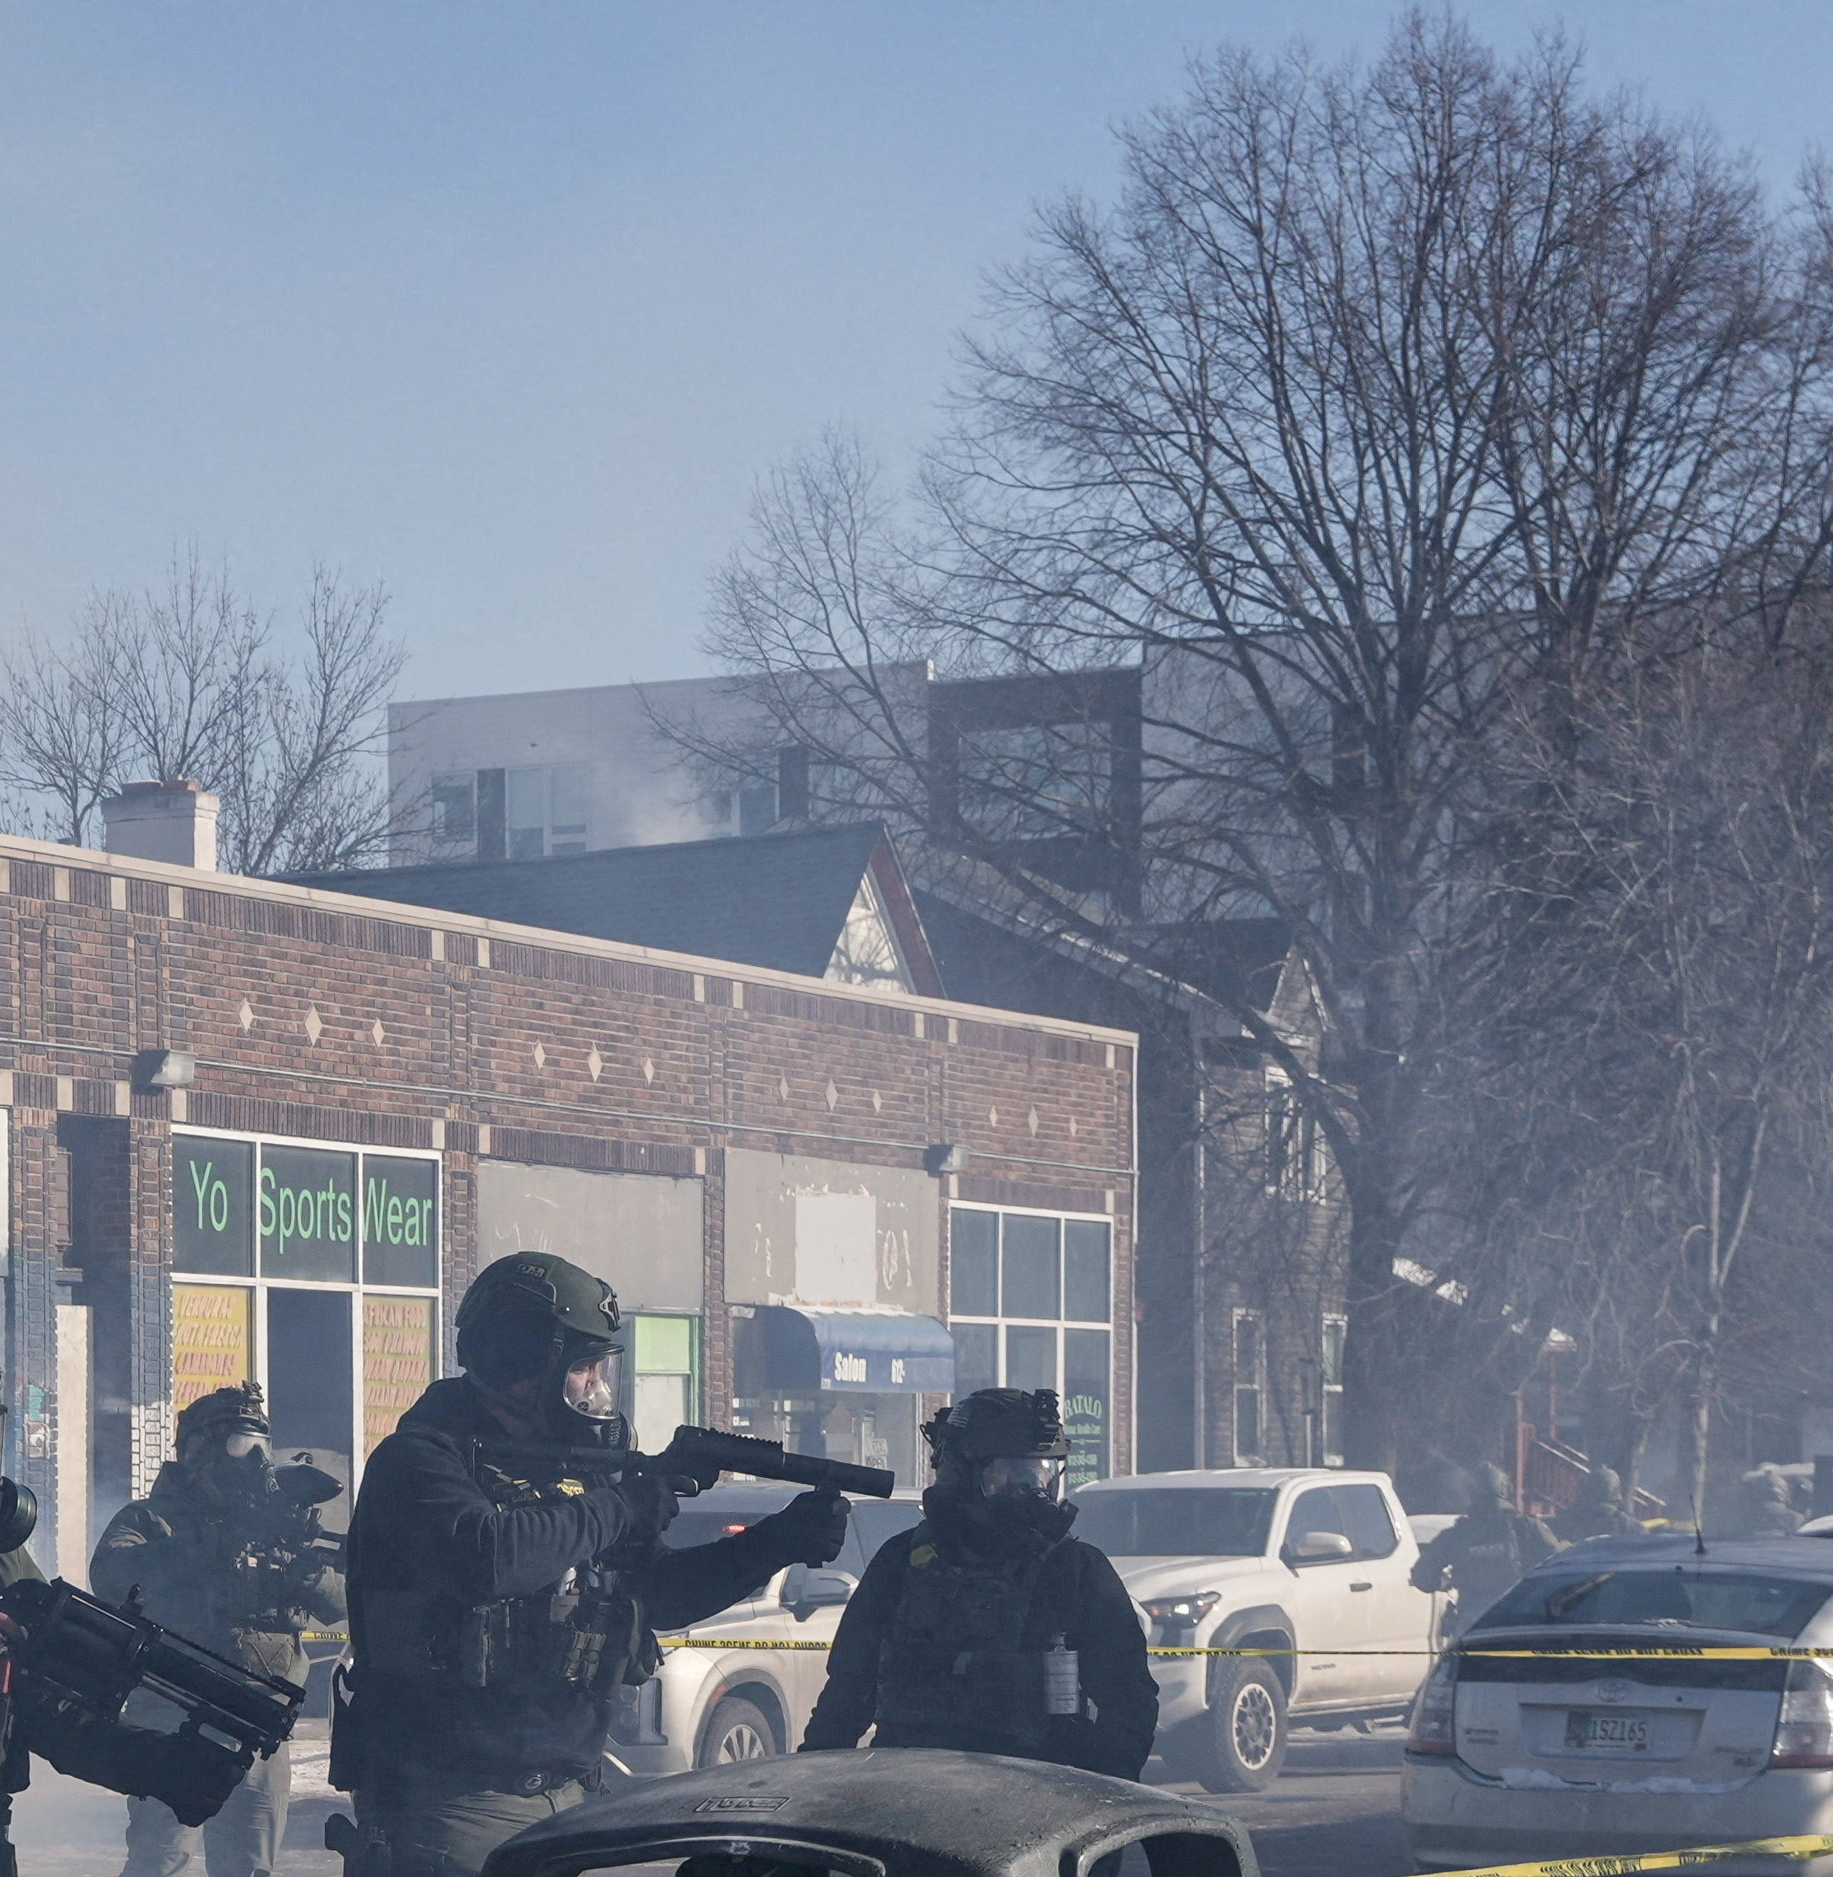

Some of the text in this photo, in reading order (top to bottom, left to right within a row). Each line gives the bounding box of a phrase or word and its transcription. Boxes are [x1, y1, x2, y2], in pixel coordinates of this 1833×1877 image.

[189, 1160, 432, 1254] Yo Sports Wear
[405, 1306, 427, 1328] FOOD
[835, 1352, 867, 1382] Salon
[1065, 1394, 1102, 1420] BATALO
